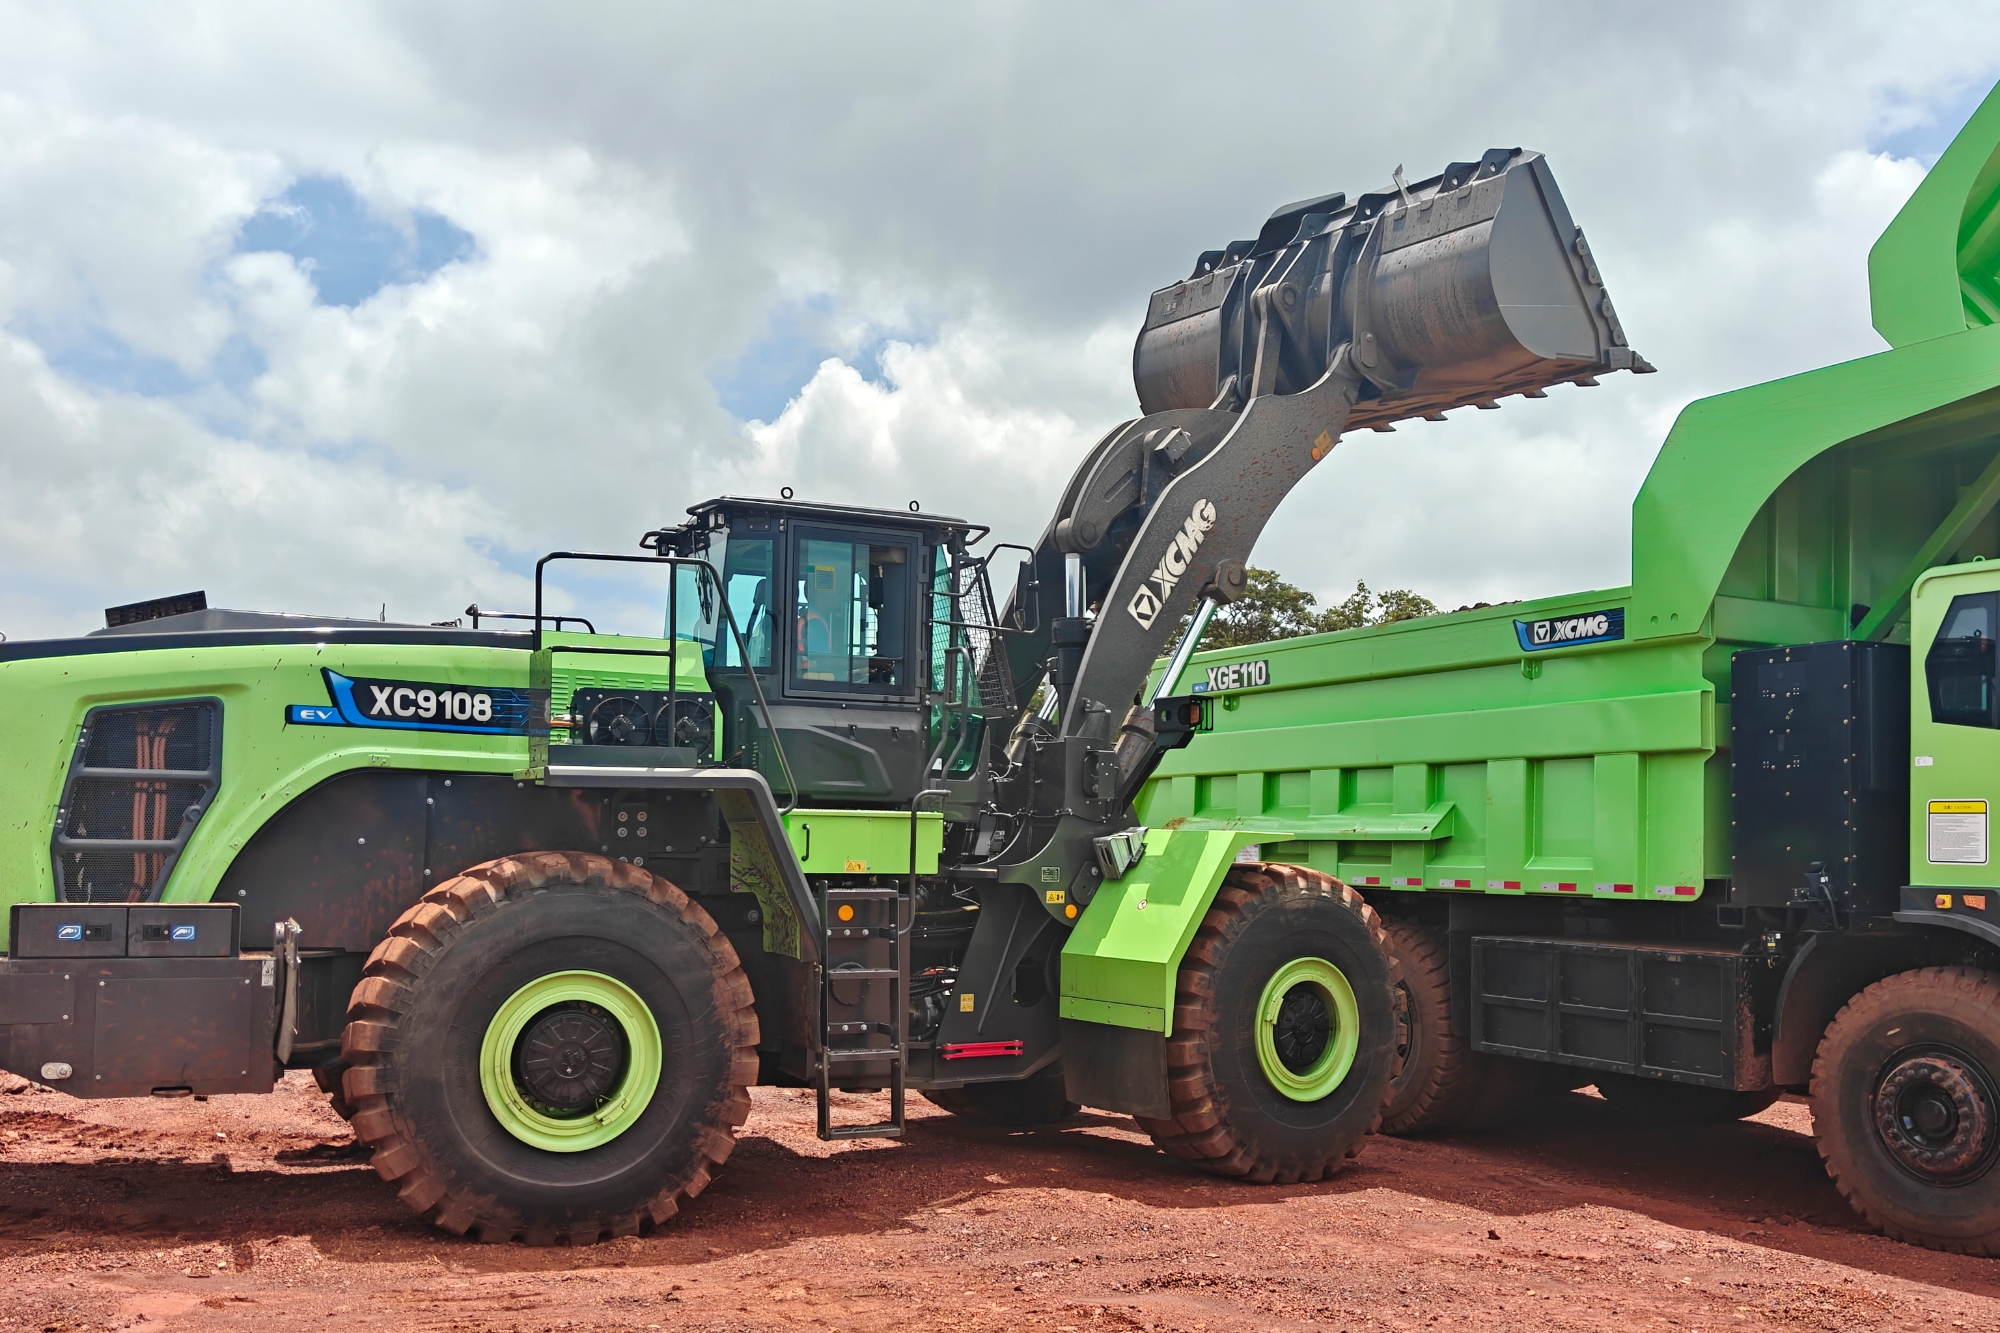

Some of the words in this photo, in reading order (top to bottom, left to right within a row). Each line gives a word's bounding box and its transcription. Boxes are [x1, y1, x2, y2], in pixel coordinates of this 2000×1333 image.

[1149, 499, 1217, 604] XCMG
[1551, 615, 1609, 642] XCMG
[1206, 661, 1267, 691] XGE110
[300, 709, 333, 720] EV
[369, 685, 492, 722] XC9108
